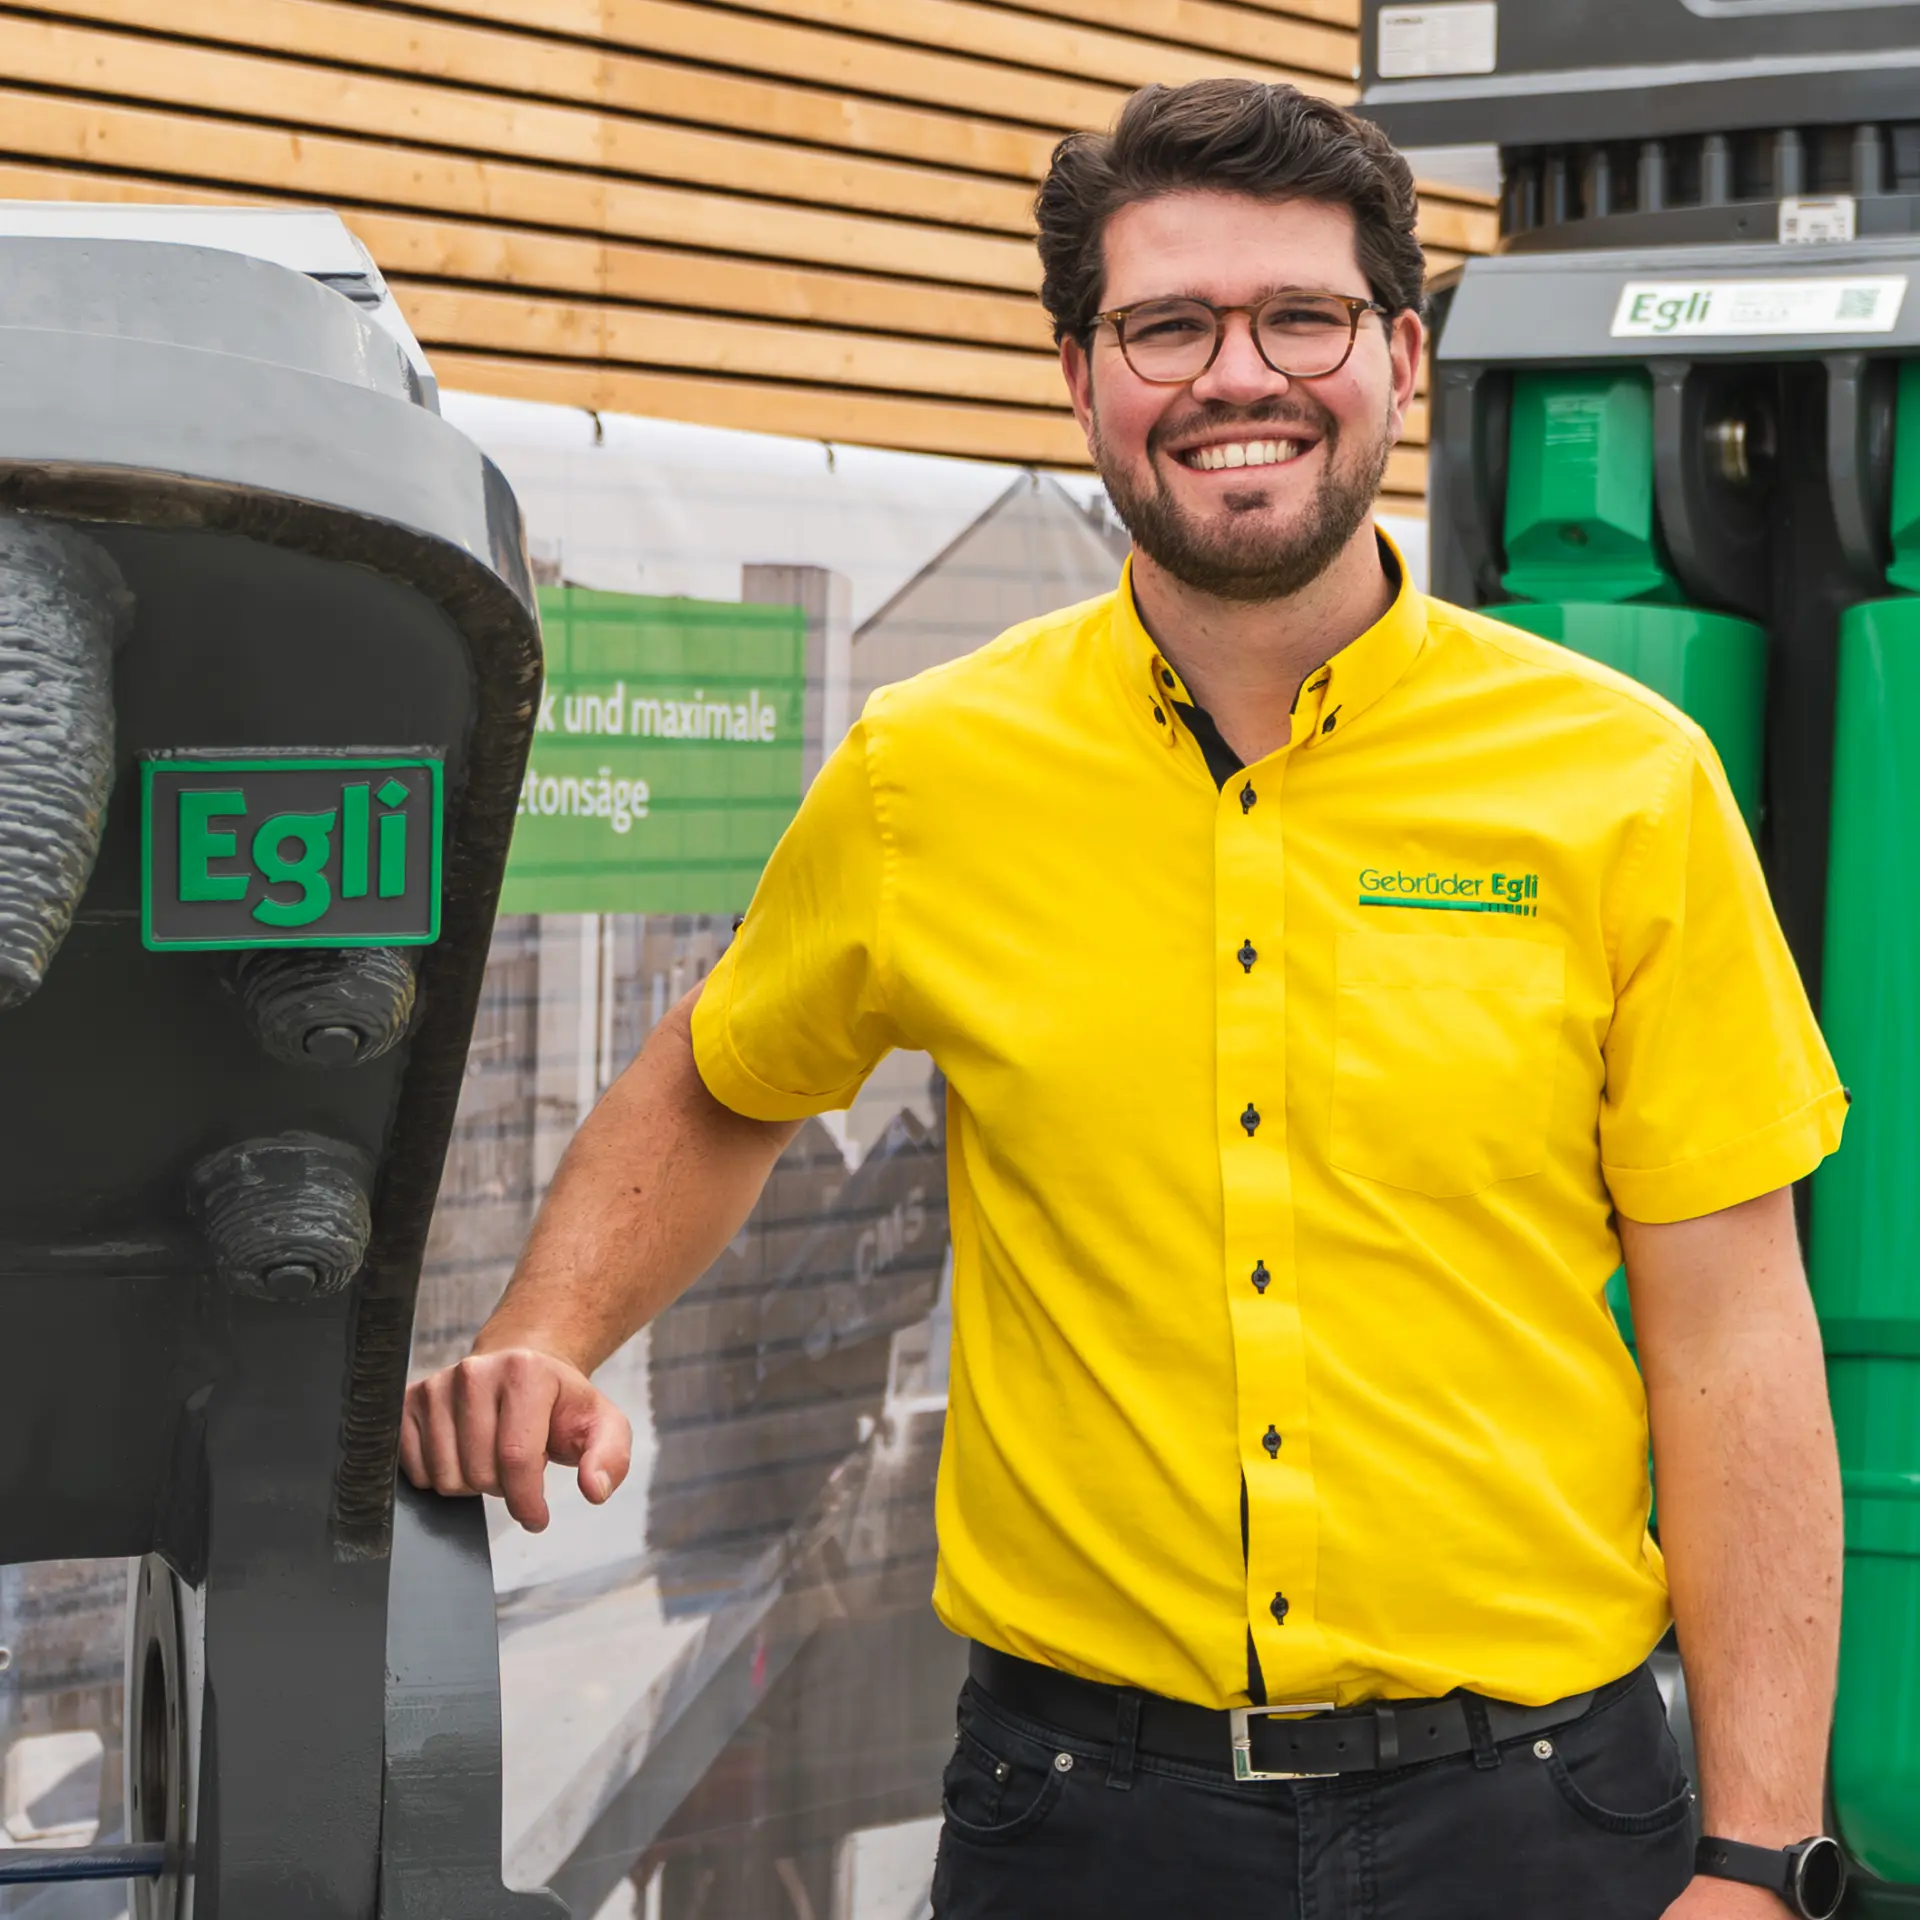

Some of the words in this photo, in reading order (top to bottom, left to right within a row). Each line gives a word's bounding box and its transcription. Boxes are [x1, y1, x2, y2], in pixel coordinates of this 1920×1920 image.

[1628, 290, 1713, 332] Egli
[563, 681, 625, 735] und
[630, 689, 776, 742] maximale
[178, 778, 410, 927] Egli
[1359, 869, 1484, 897] Gebrüder
[1491, 873, 1538, 902] Egli
